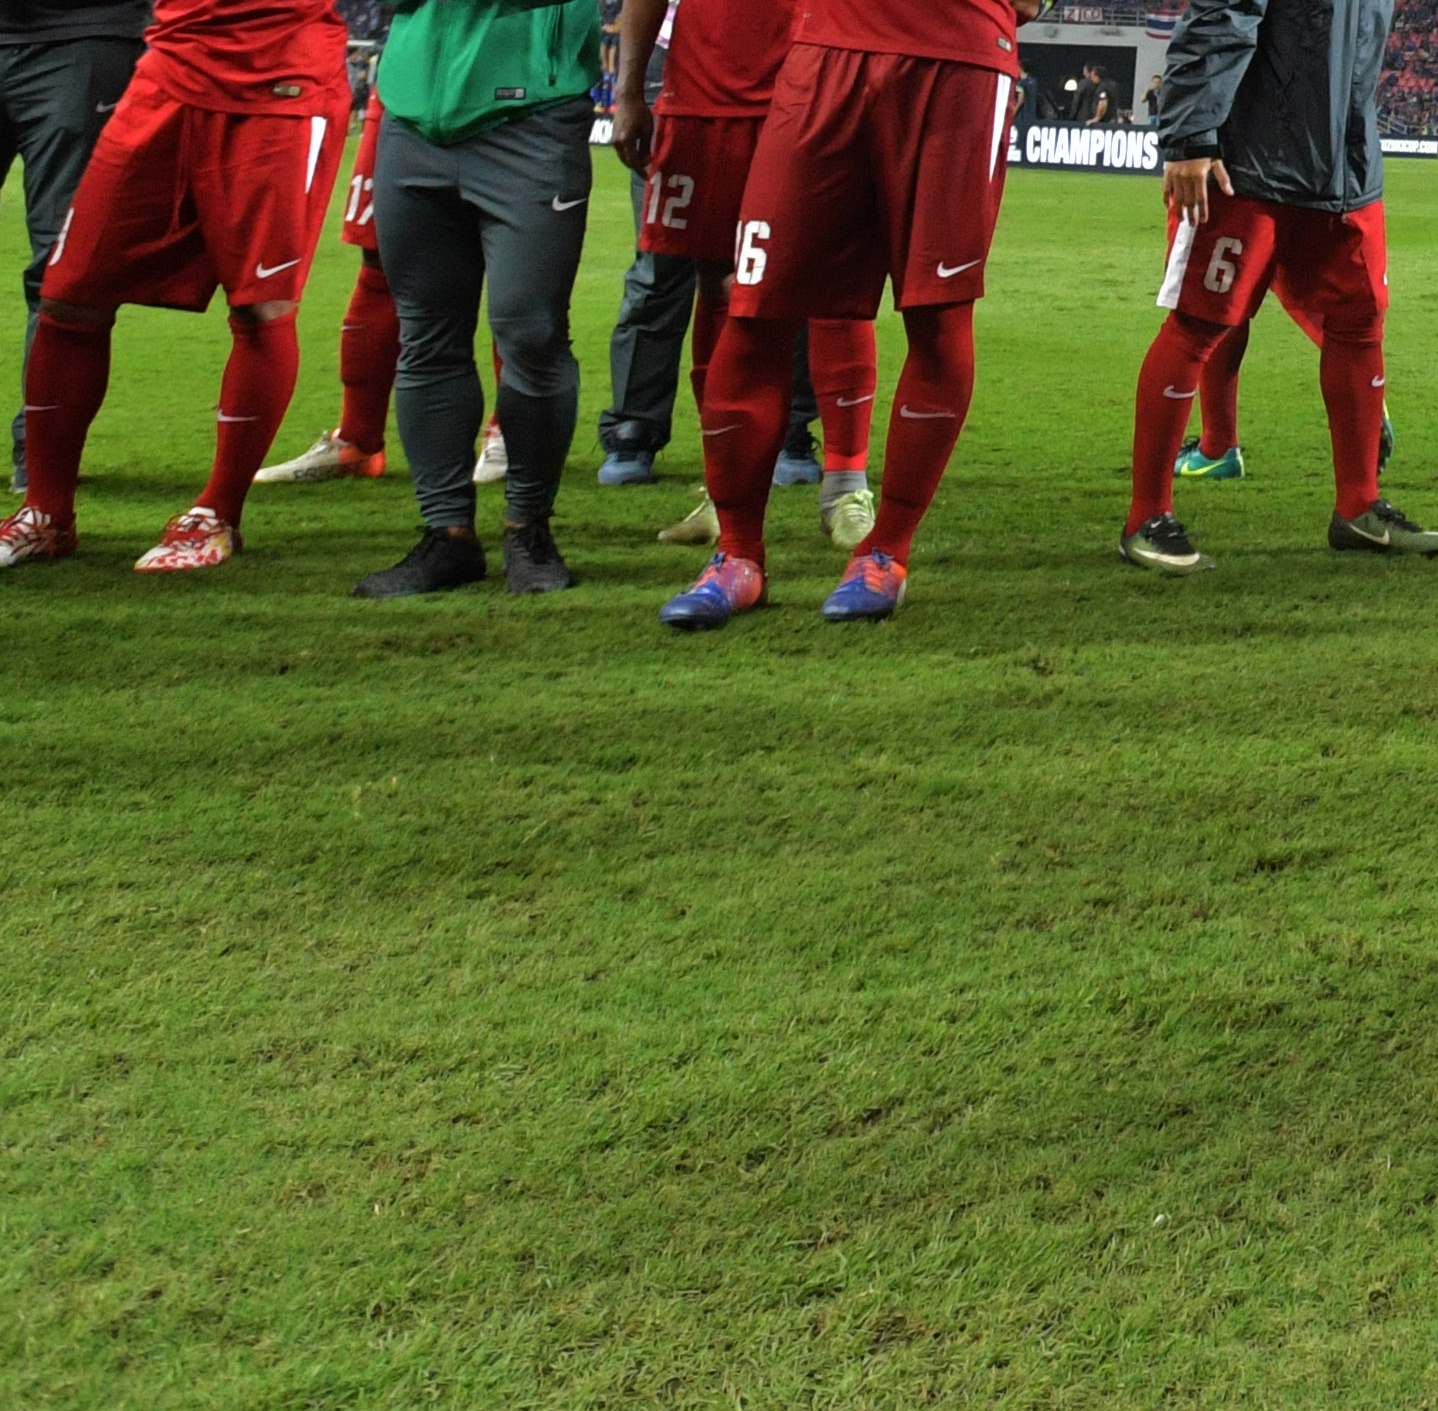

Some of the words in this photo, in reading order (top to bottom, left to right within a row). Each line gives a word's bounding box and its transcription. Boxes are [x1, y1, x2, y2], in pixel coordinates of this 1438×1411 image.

[1026, 126, 1159, 170] CHAMPIONS
[646, 171, 695, 230] 12
[1204, 236, 1243, 294] 6
